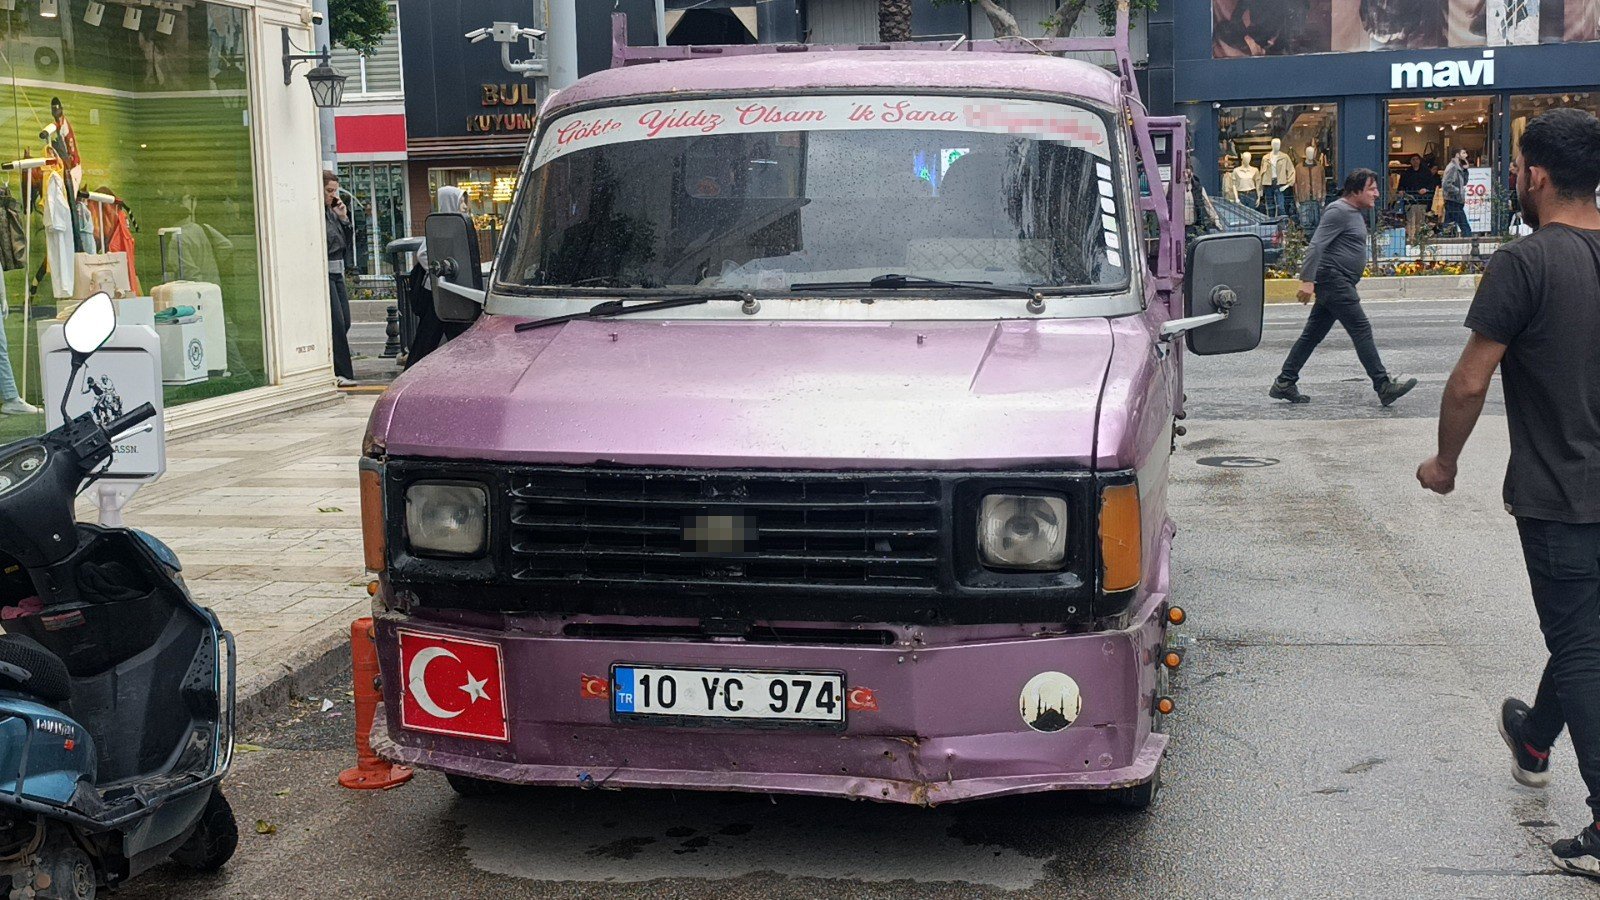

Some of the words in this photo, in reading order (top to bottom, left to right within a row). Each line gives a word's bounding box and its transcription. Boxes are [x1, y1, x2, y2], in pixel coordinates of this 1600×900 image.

[1391, 50, 1495, 89] mavi
[638, 108, 726, 138] Yıldız
[735, 103, 828, 126] Olsam
[881, 101, 959, 123] Sana
[1466, 184, 1486, 197] 30
[618, 692, 633, 704] TR
[639, 674, 677, 709] 10
[701, 677, 744, 712] YC
[768, 679, 837, 714] 974
